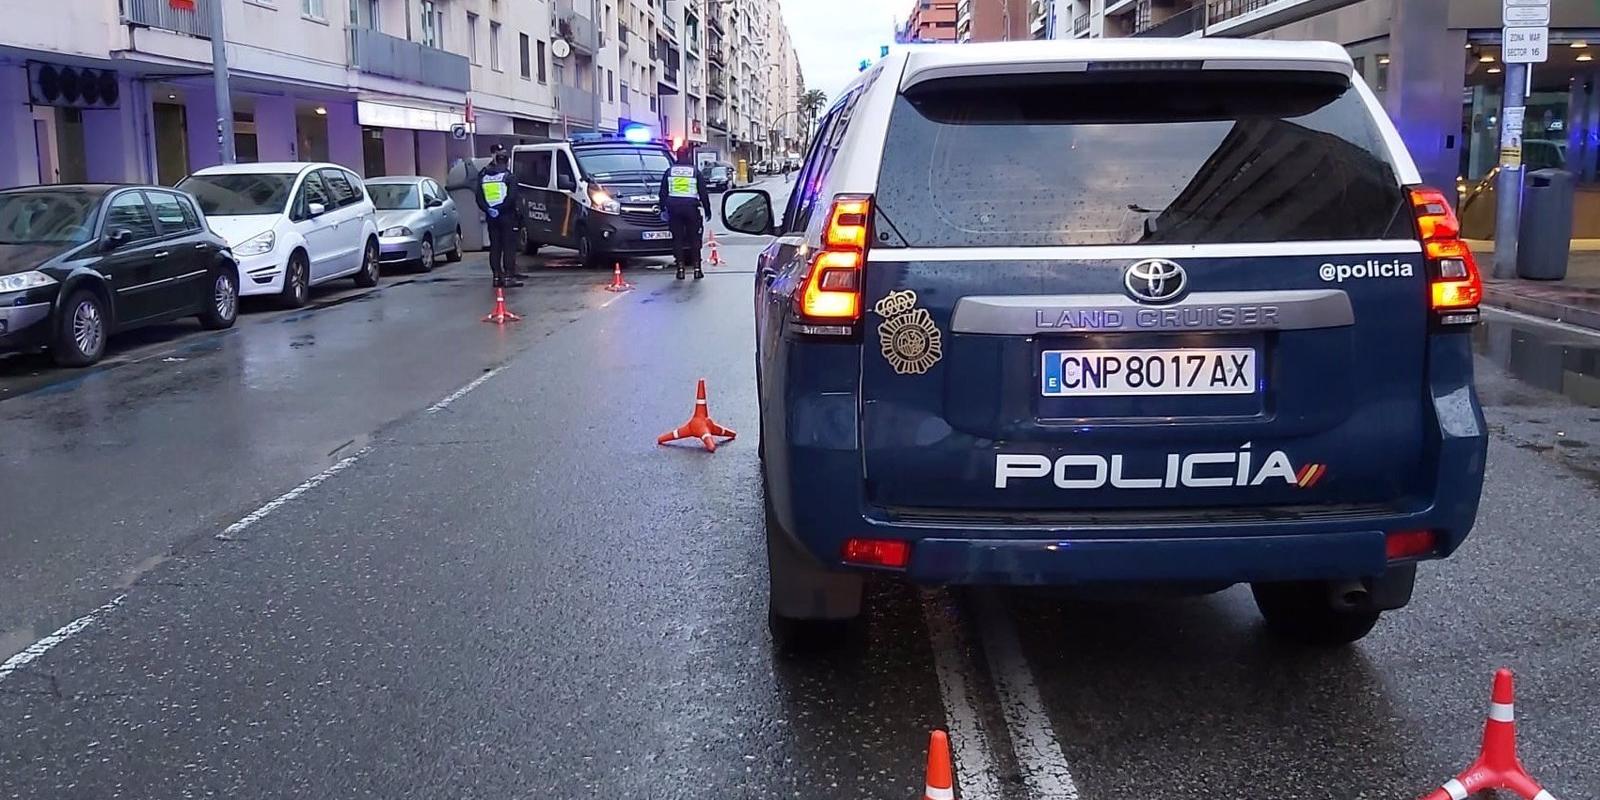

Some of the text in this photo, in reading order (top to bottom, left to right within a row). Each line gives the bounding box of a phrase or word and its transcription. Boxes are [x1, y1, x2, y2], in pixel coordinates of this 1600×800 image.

[1507, 48, 1540, 57] SECTOR 16
[1319, 260, 1413, 282] @policia
[1035, 306, 1280, 328] LAND CRUISER
[1048, 377, 1058, 388] E
[1060, 354, 1249, 389] CNP8017AX
[994, 441, 1298, 489] POLICÍA
